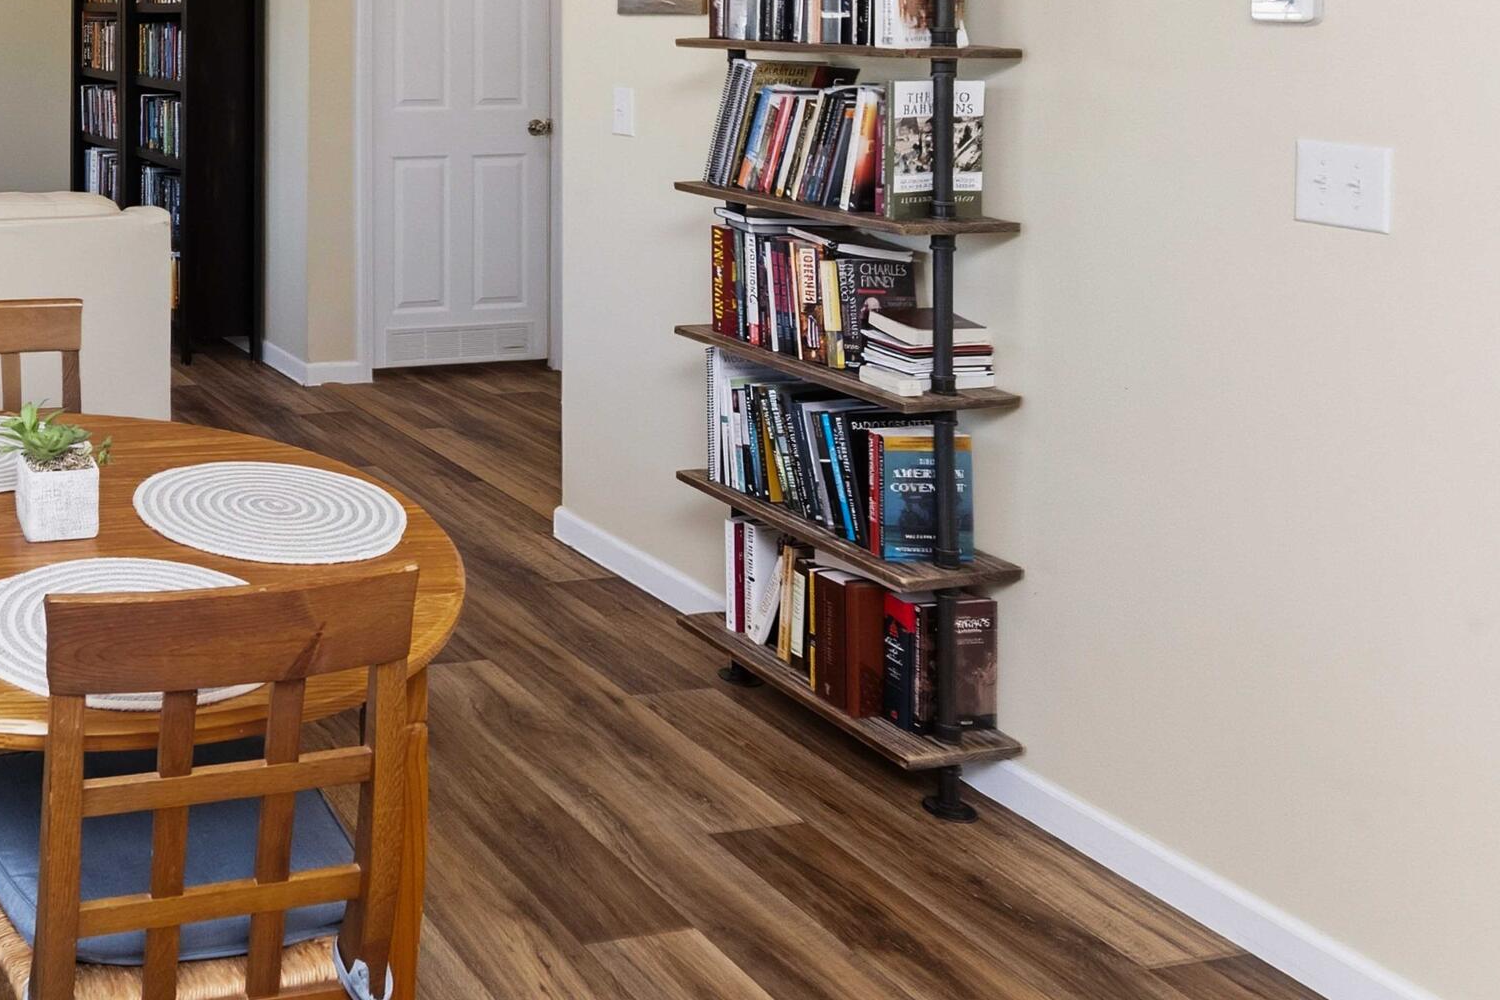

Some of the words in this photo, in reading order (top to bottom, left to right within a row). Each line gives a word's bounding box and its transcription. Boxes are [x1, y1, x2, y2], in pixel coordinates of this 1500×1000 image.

[903, 103, 973, 115] BABYNS
[860, 263, 908, 277] CHARLES
[861, 276, 895, 288] FINNEY
